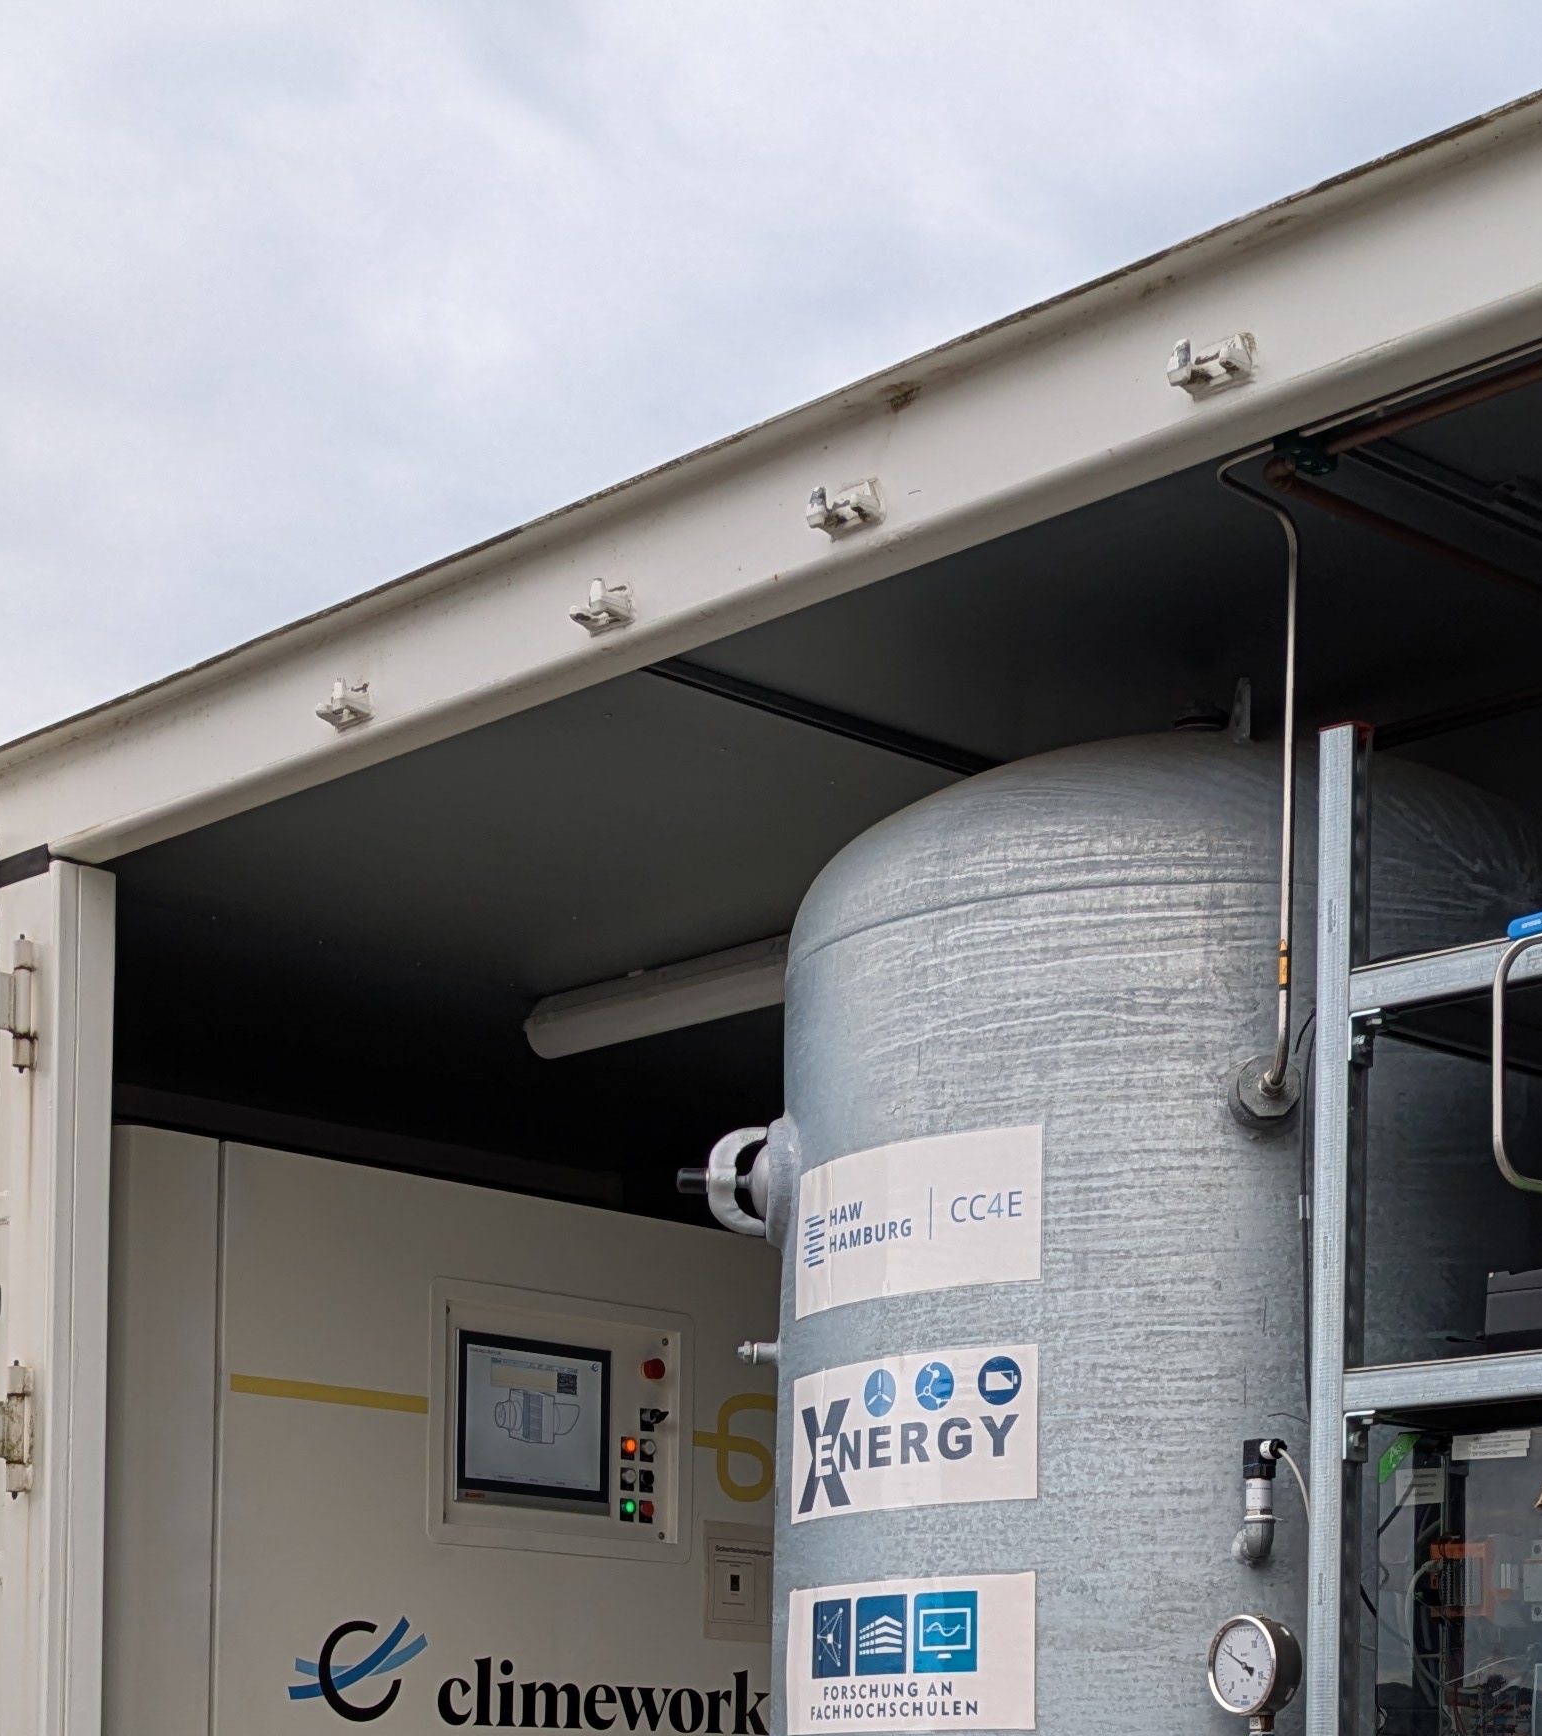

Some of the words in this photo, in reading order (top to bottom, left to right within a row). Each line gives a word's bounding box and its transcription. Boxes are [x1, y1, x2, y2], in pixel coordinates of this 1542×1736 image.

[829, 1200, 863, 1227] HAW
[950, 1190, 1023, 1224] CC4E
[828, 1217, 913, 1254] HAMBURG
[437, 1655, 771, 1736] climework
[822, 1682, 919, 1702] FORSCHUNG
[927, 1681, 954, 1697] AN
[810, 1700, 979, 1721] FACHHOCHSCHULEN
